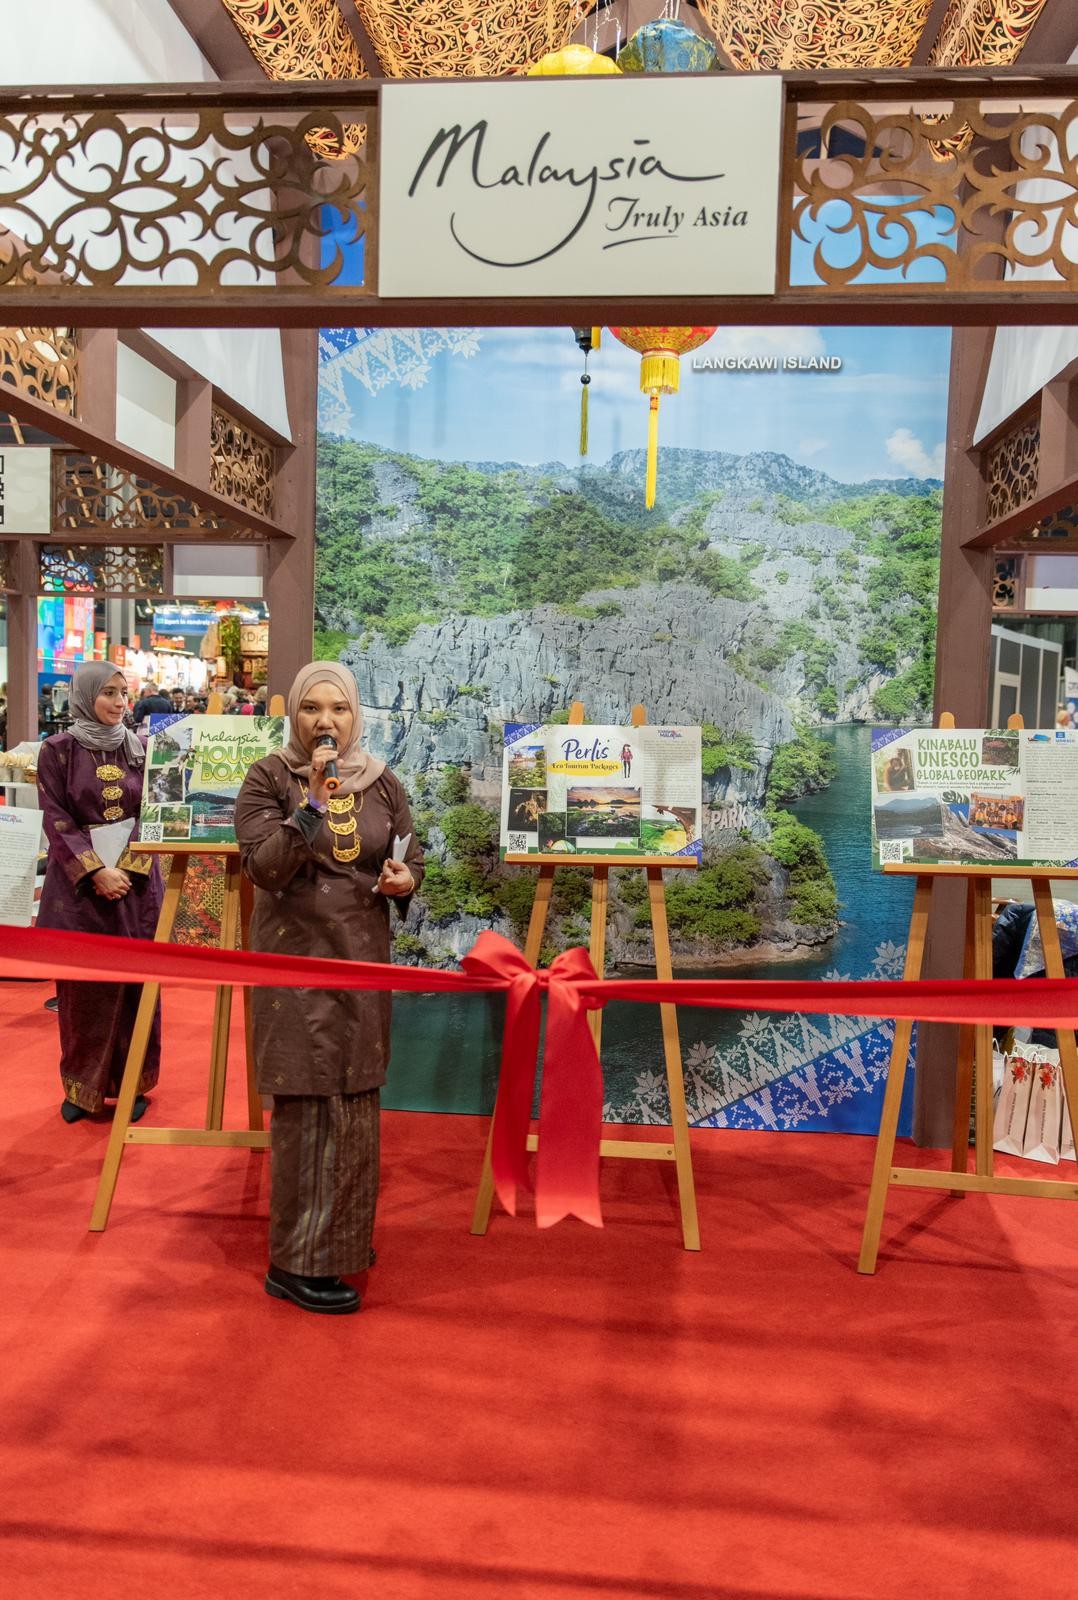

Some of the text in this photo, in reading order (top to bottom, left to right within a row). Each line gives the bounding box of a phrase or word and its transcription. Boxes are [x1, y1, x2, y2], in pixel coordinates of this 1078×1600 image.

[408, 119, 725, 267] Malaysia
[605, 197, 749, 232] Truly Asia
[692, 356, 842, 370] LANGKAWI ISLAND
[200, 731, 260, 745] Malaysia
[917, 738, 977, 751] KINABALU
[195, 745, 267, 765] HOUSE
[561, 738, 610, 761] Perlis
[917, 751, 980, 768] UNESCO
[201, 763, 250, 781] BOA
[916, 769, 1007, 781] GLOBAL GEOPARK
